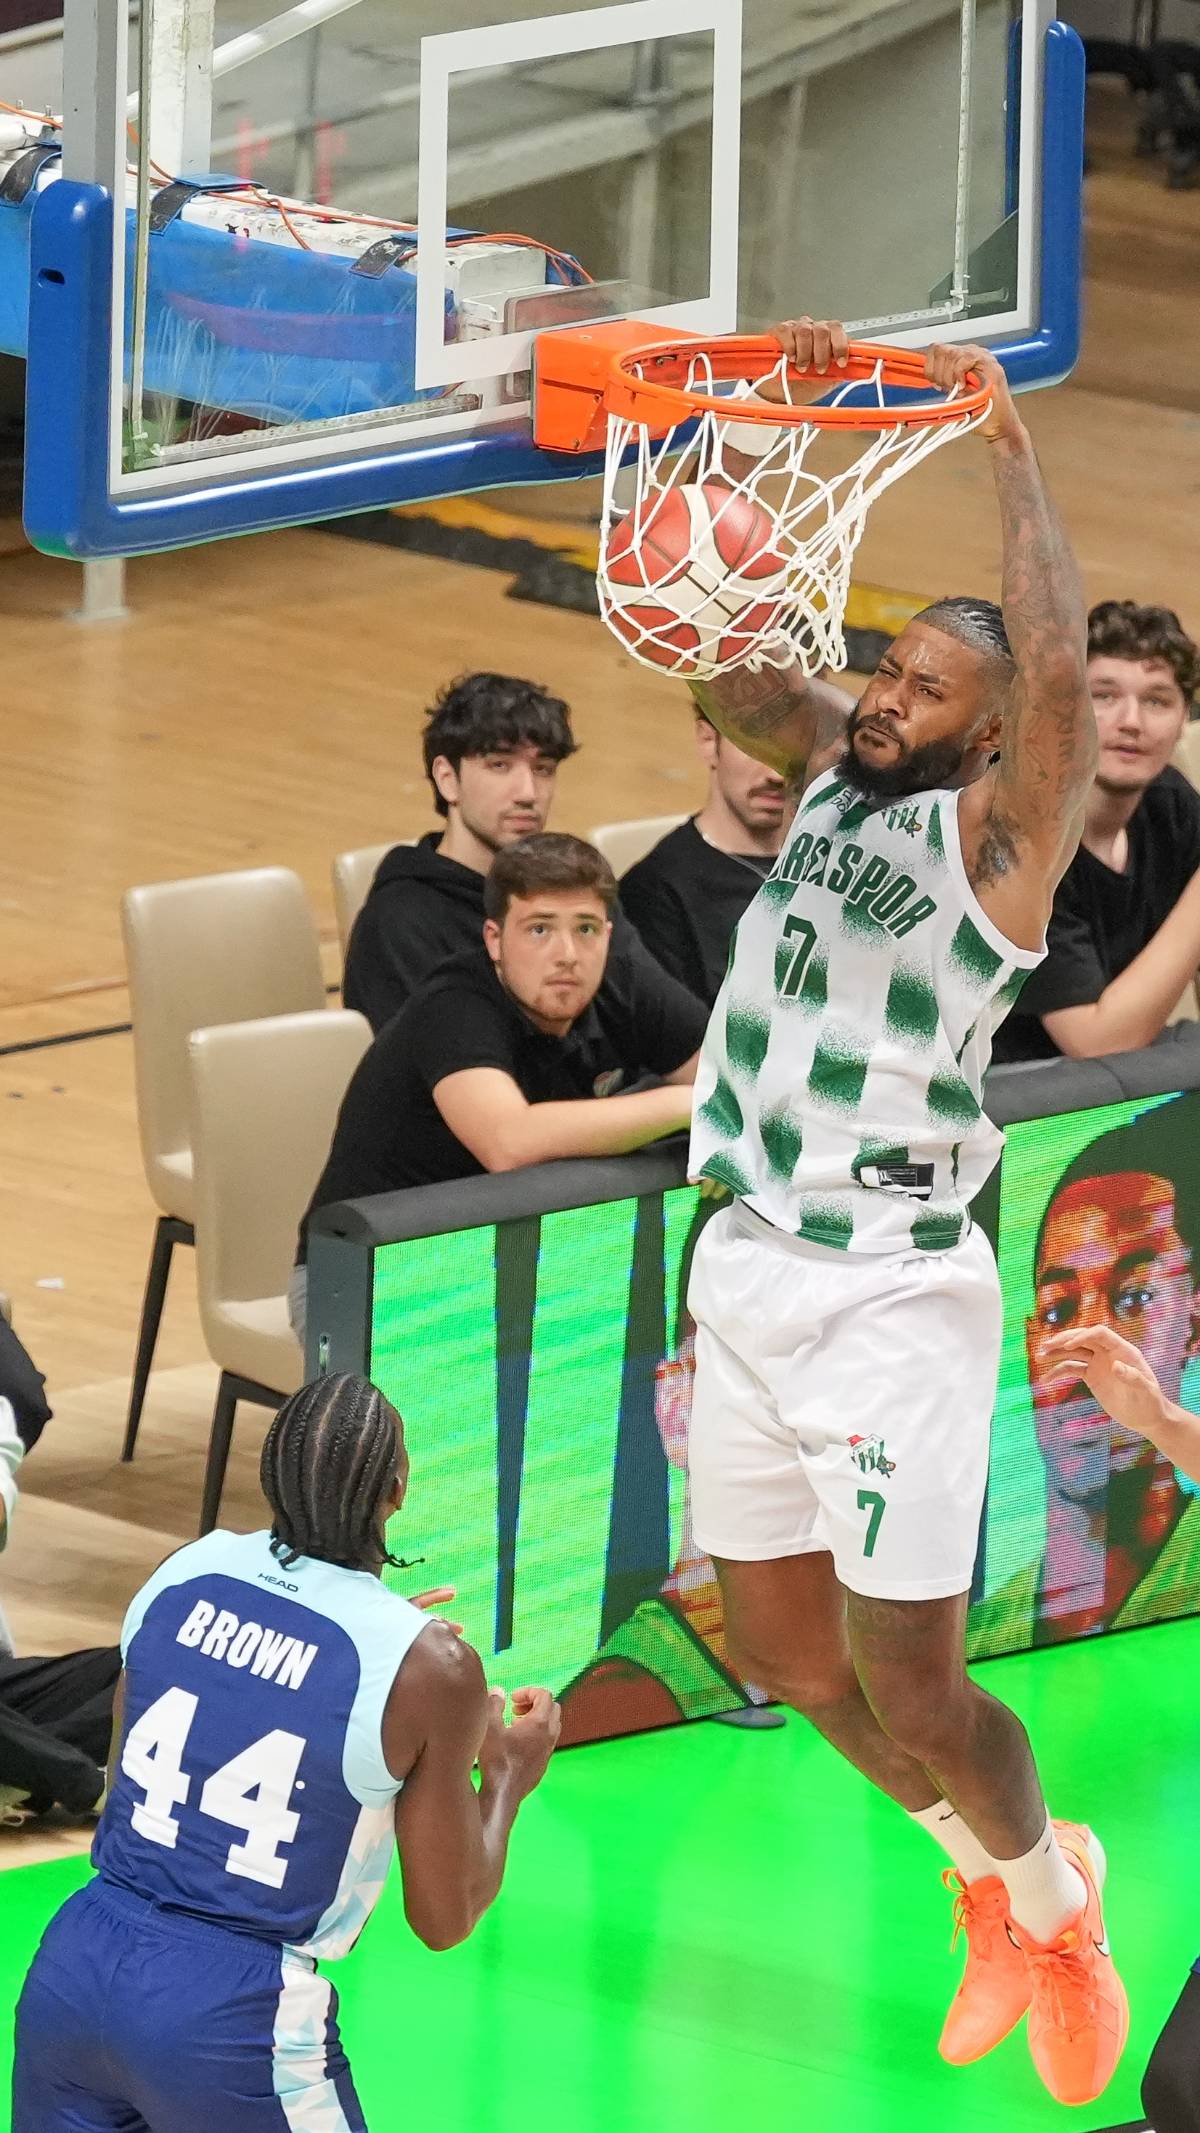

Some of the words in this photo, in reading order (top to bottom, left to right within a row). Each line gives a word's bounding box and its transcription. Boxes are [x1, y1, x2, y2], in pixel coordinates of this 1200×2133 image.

[782, 913, 818, 998] 7
[857, 1488, 886, 1558] 7
[257, 1572, 299, 1593] HEAD
[175, 1599, 319, 1690] BROWN
[121, 1686, 307, 1890] 44
